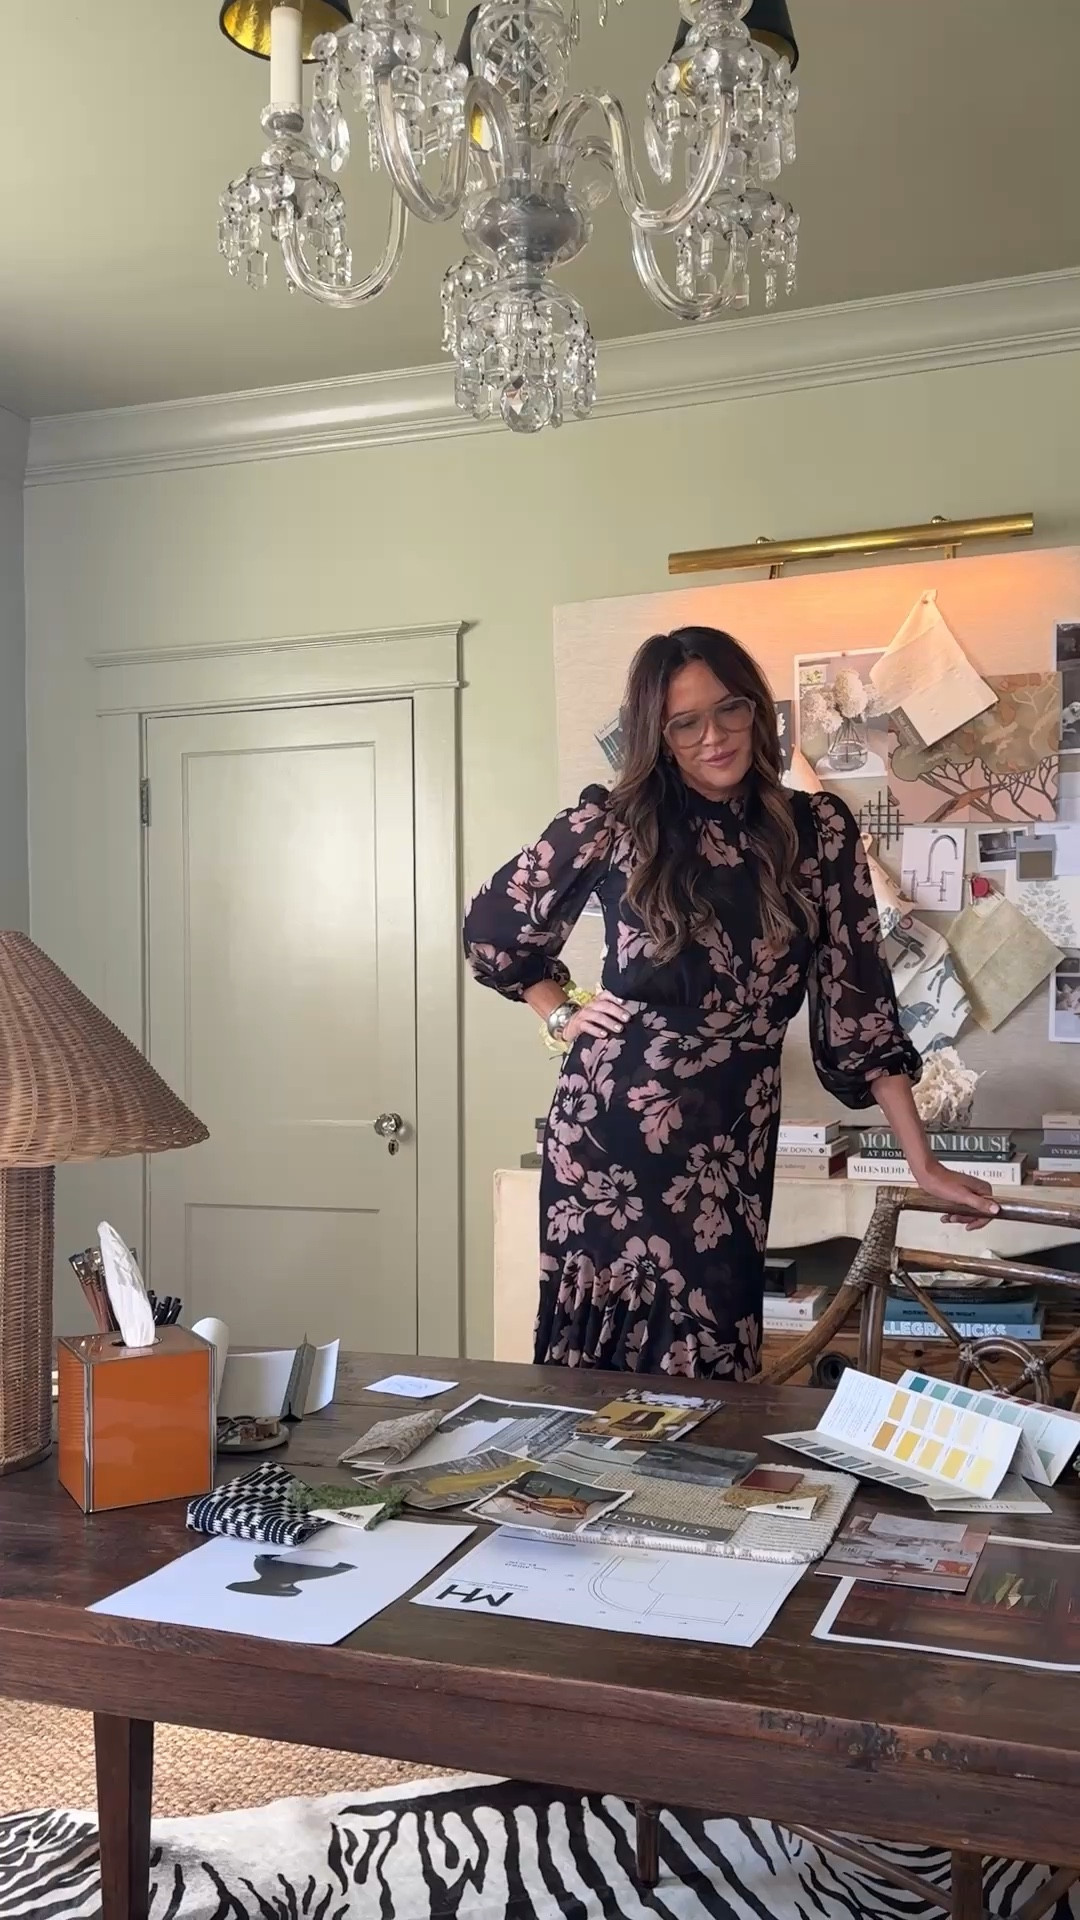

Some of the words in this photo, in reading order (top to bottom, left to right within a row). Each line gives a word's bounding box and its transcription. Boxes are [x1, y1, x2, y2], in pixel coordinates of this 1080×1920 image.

[859, 1132, 948, 1151] MOUIN
[790, 1146, 814, 1154] DOWN
[881, 1150, 906, 1158] HOM
[853, 1164, 879, 1173] MILES
[881, 1166, 905, 1175] REDD
[951, 1323, 1008, 1338] HICKS
[435, 1583, 514, 1608] MH
